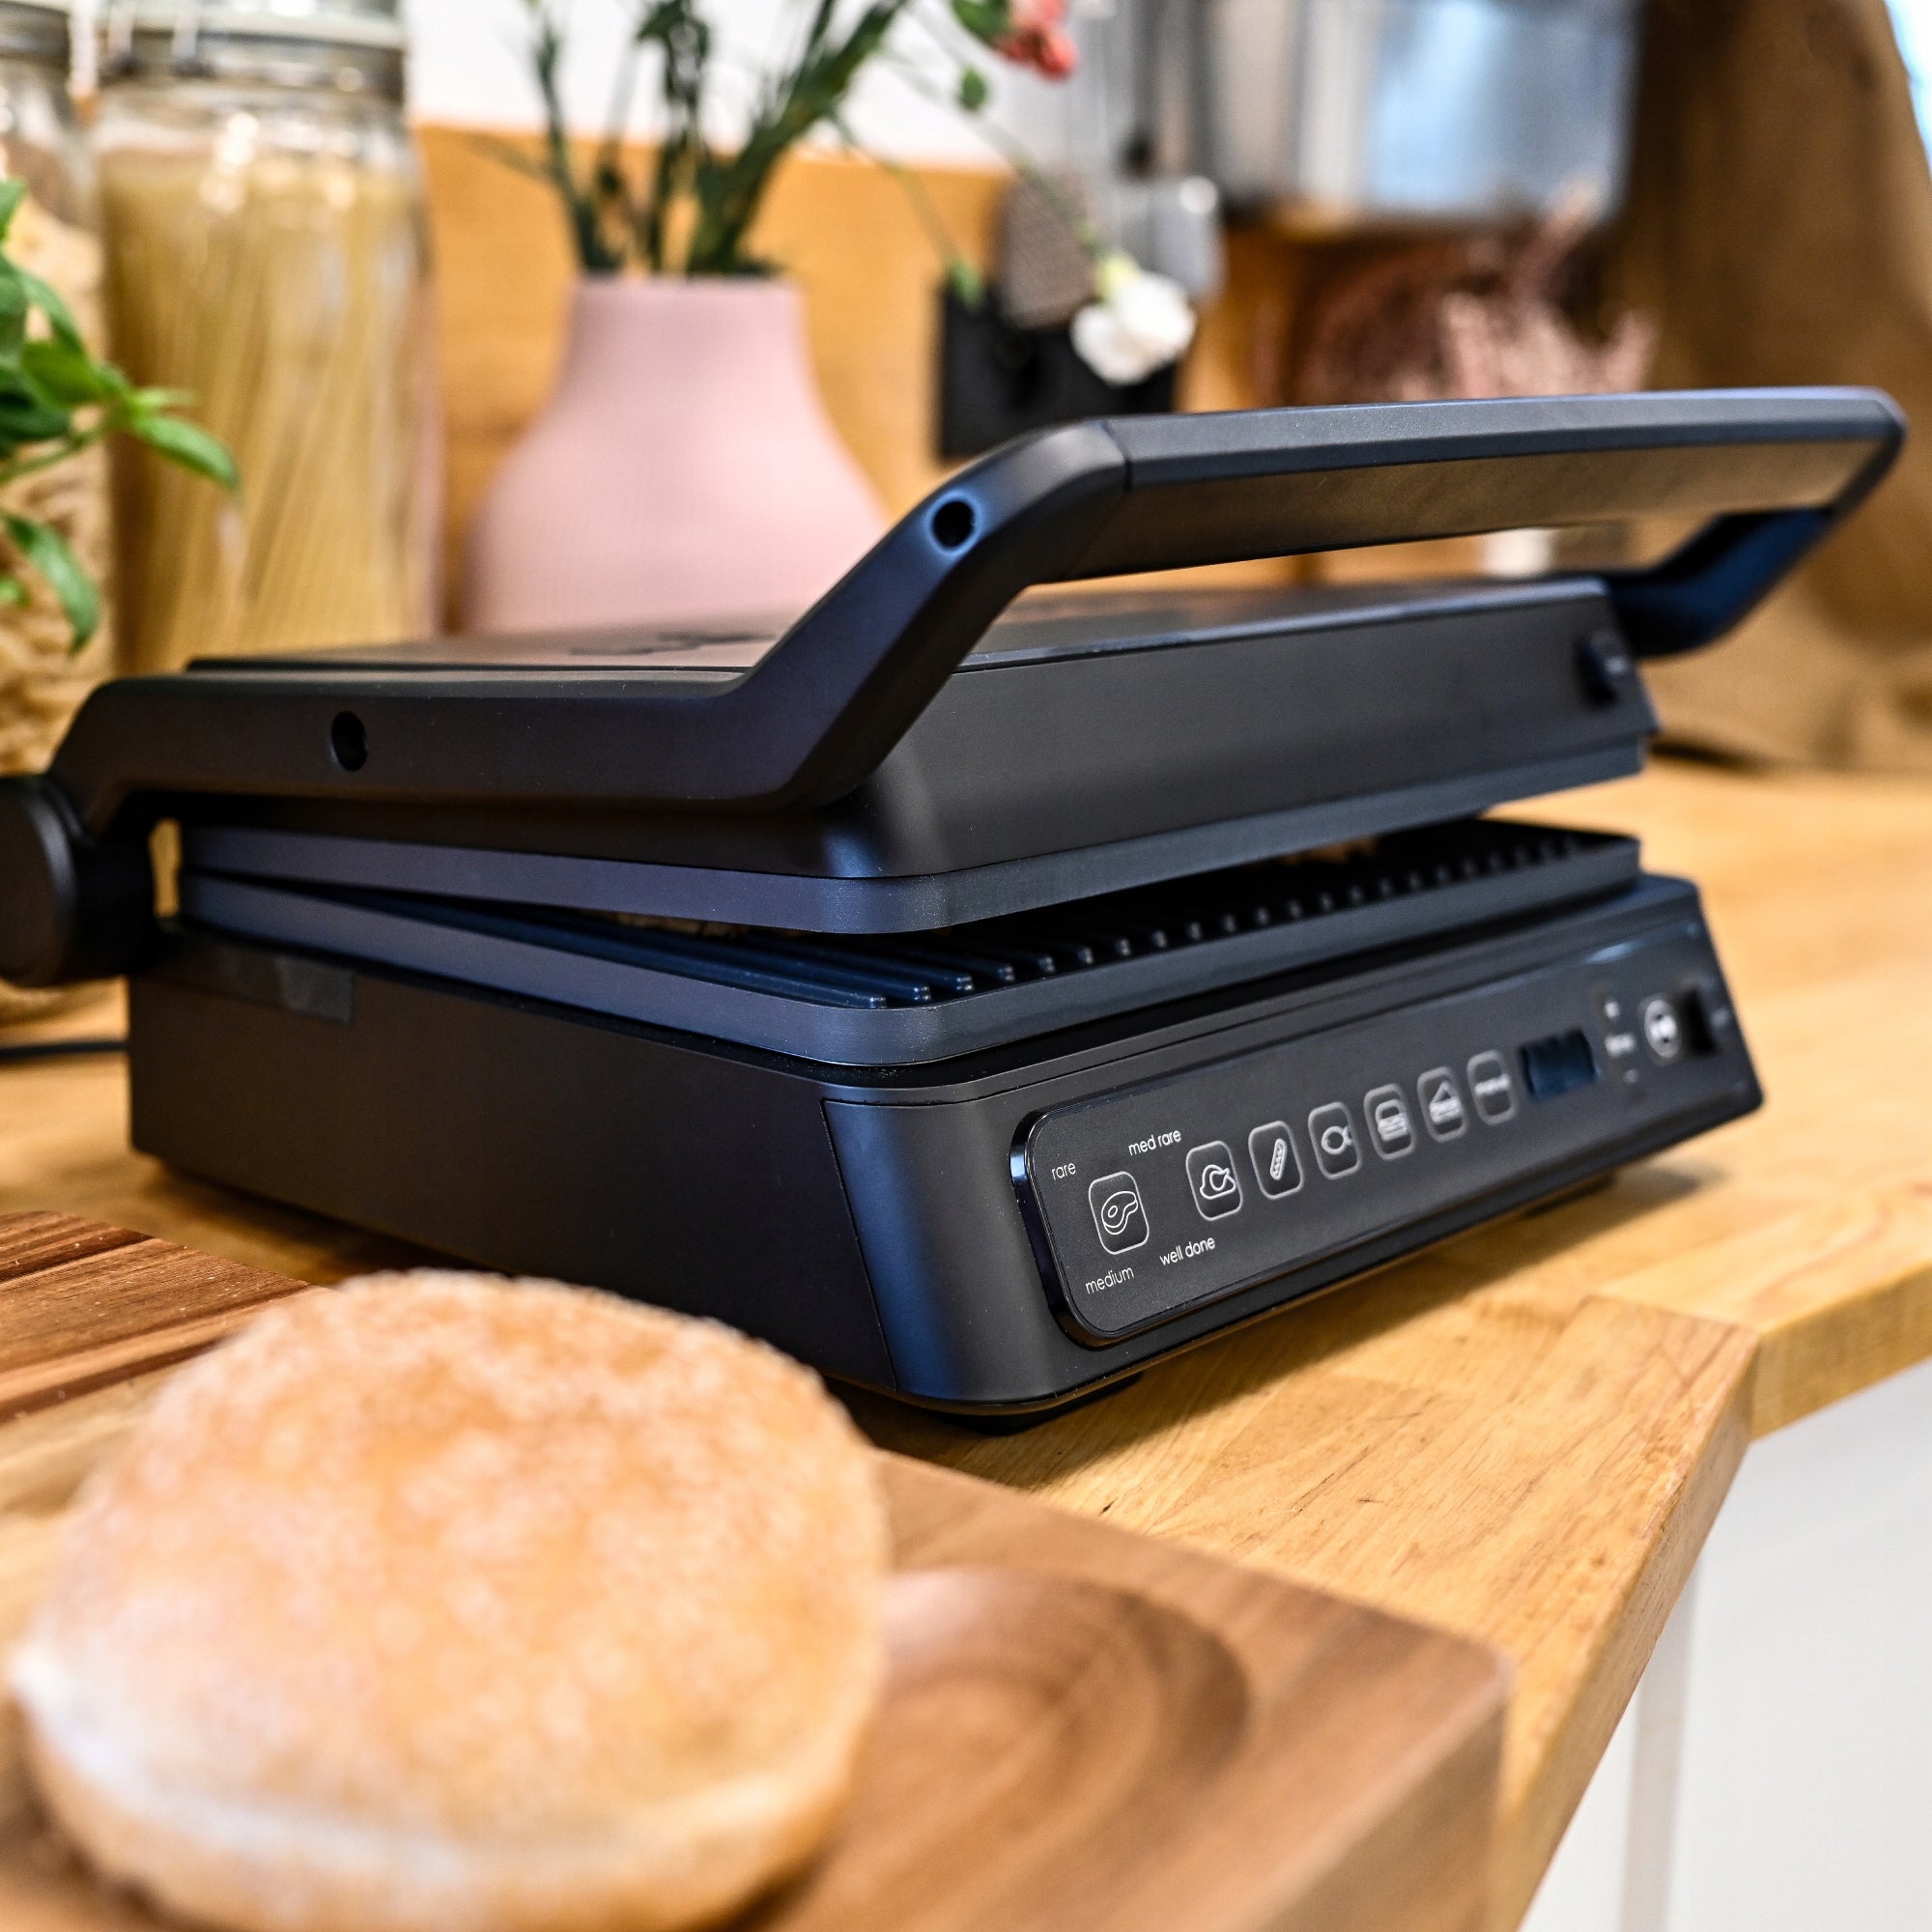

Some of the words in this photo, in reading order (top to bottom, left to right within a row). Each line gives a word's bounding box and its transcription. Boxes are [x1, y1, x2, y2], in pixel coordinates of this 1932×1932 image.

[1128, 1134, 1156, 1156] med
[1157, 1129, 1182, 1148] rare
[1051, 1161, 1076, 1180] rare
[1158, 1245, 1184, 1266] well
[1184, 1236, 1216, 1259] done
[1085, 1266, 1135, 1294] medium
